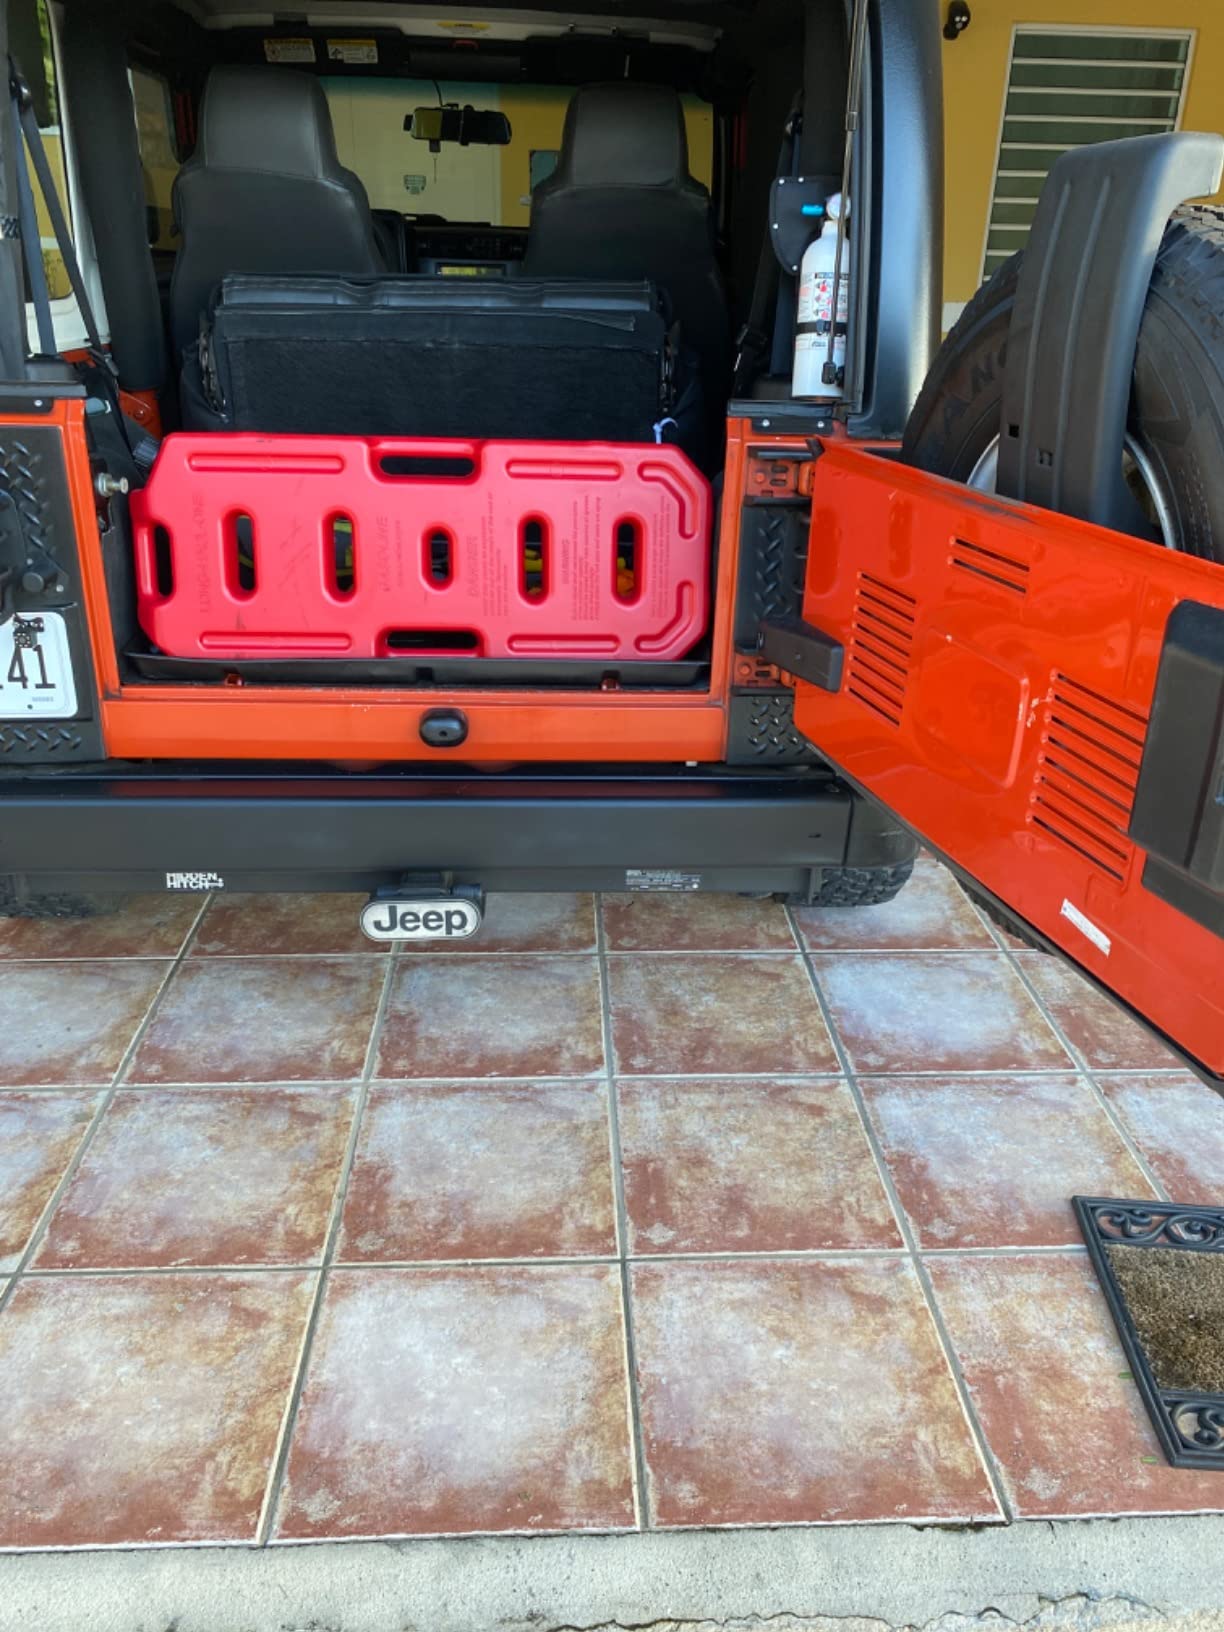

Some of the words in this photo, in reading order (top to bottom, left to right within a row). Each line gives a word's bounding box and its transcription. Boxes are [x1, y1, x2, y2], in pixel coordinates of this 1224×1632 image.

[0, 645, 56, 690] 41
[166, 880, 210, 890] HITCH
[373, 905, 468, 935] Jeep
